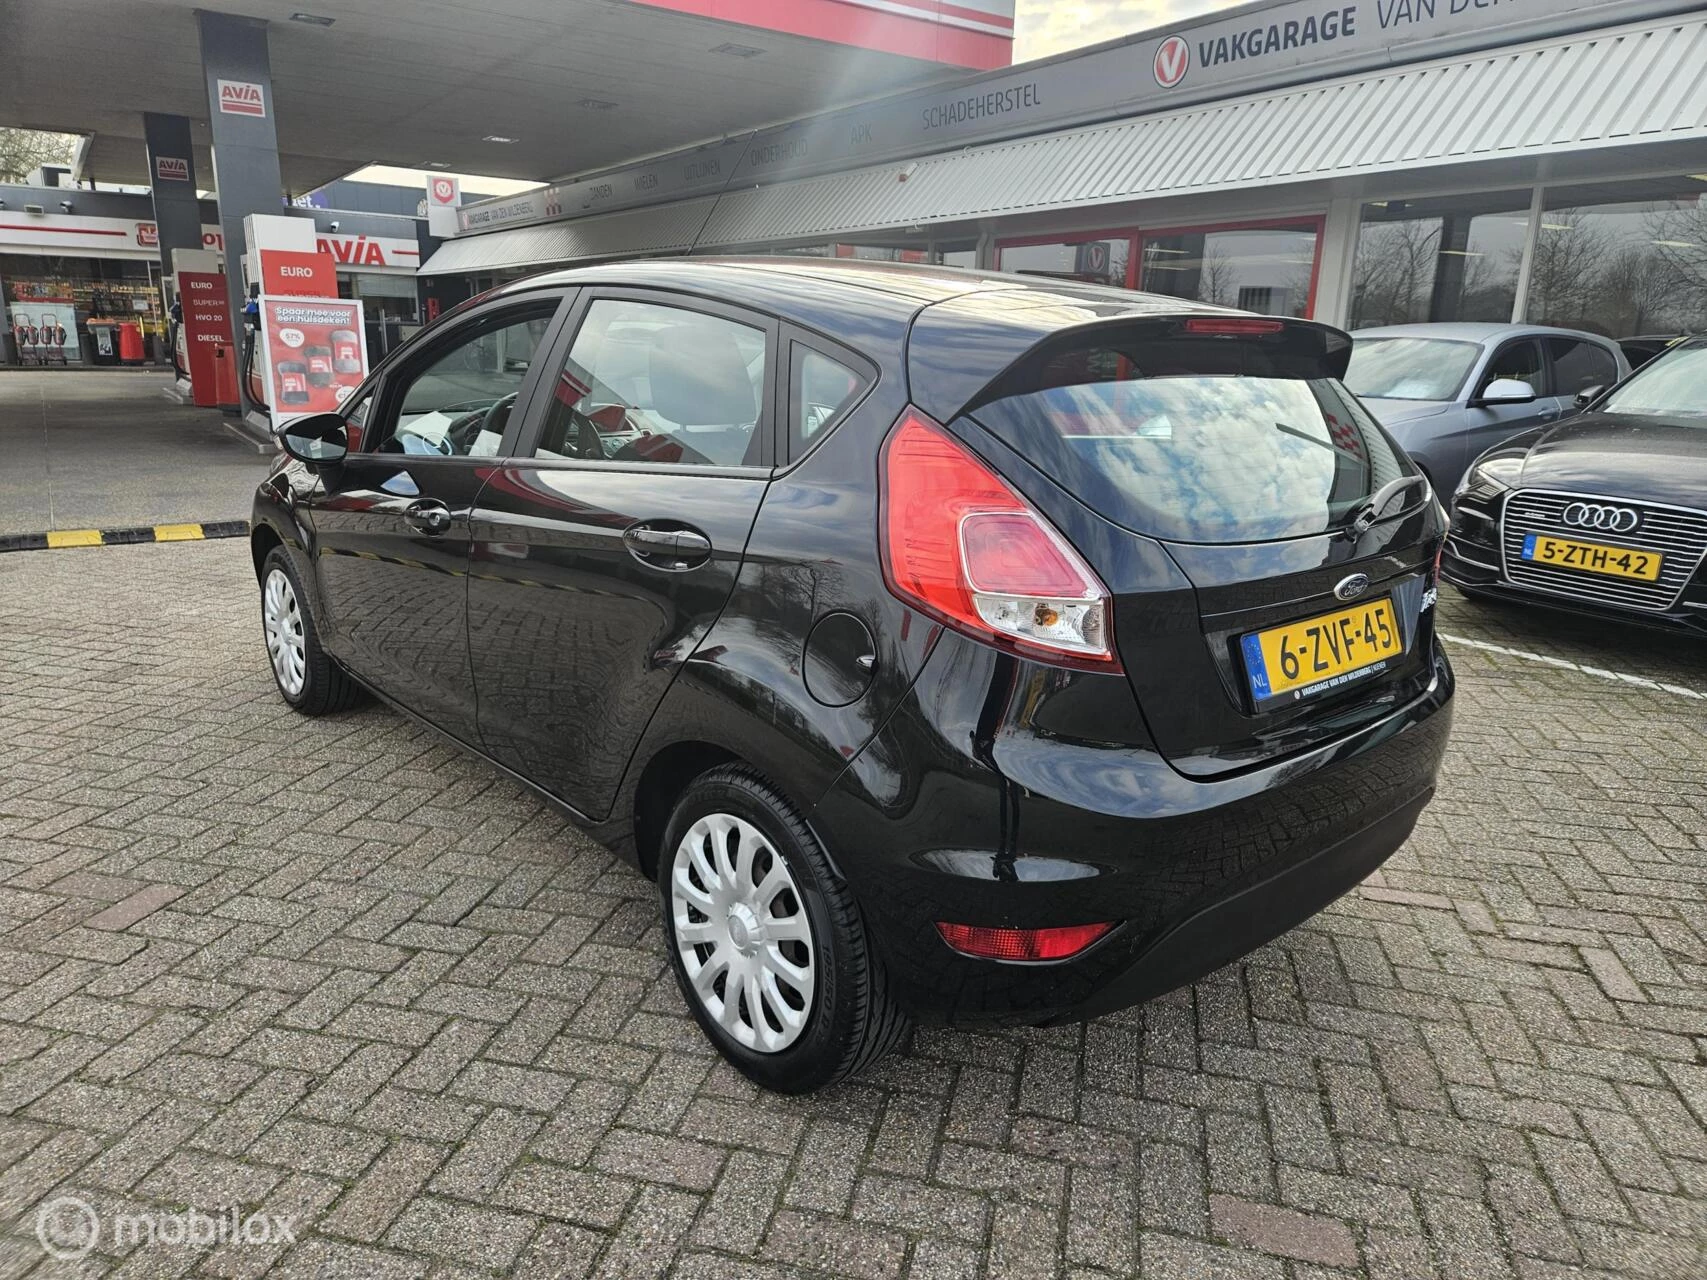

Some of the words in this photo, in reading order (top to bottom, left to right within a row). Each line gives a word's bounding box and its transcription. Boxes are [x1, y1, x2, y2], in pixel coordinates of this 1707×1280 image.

[1199, 7, 1356, 67] VAKGARAGE
[1377, 0, 1435, 29] VAN
[221, 84, 261, 102] AVIA
[922, 83, 1041, 130] SCHADEHERSTEL
[850, 123, 873, 145] APK
[751, 139, 808, 167] ONDERHOUD
[159, 159, 187, 171] AVIA
[317, 235, 386, 265] AVIA
[280, 266, 313, 278] EURO
[190, 281, 213, 289] EURO
[275, 306, 305, 317] Spaar
[307, 309, 330, 317] mee
[330, 310, 351, 318] voor
[197, 334, 224, 342] DIESEL
[1542, 541, 1649, 576] 5-ZTH-42
[1344, 580, 1368, 597] Ford
[1280, 608, 1392, 680] 6-ZVF-45
[1252, 673, 1268, 689] NL
